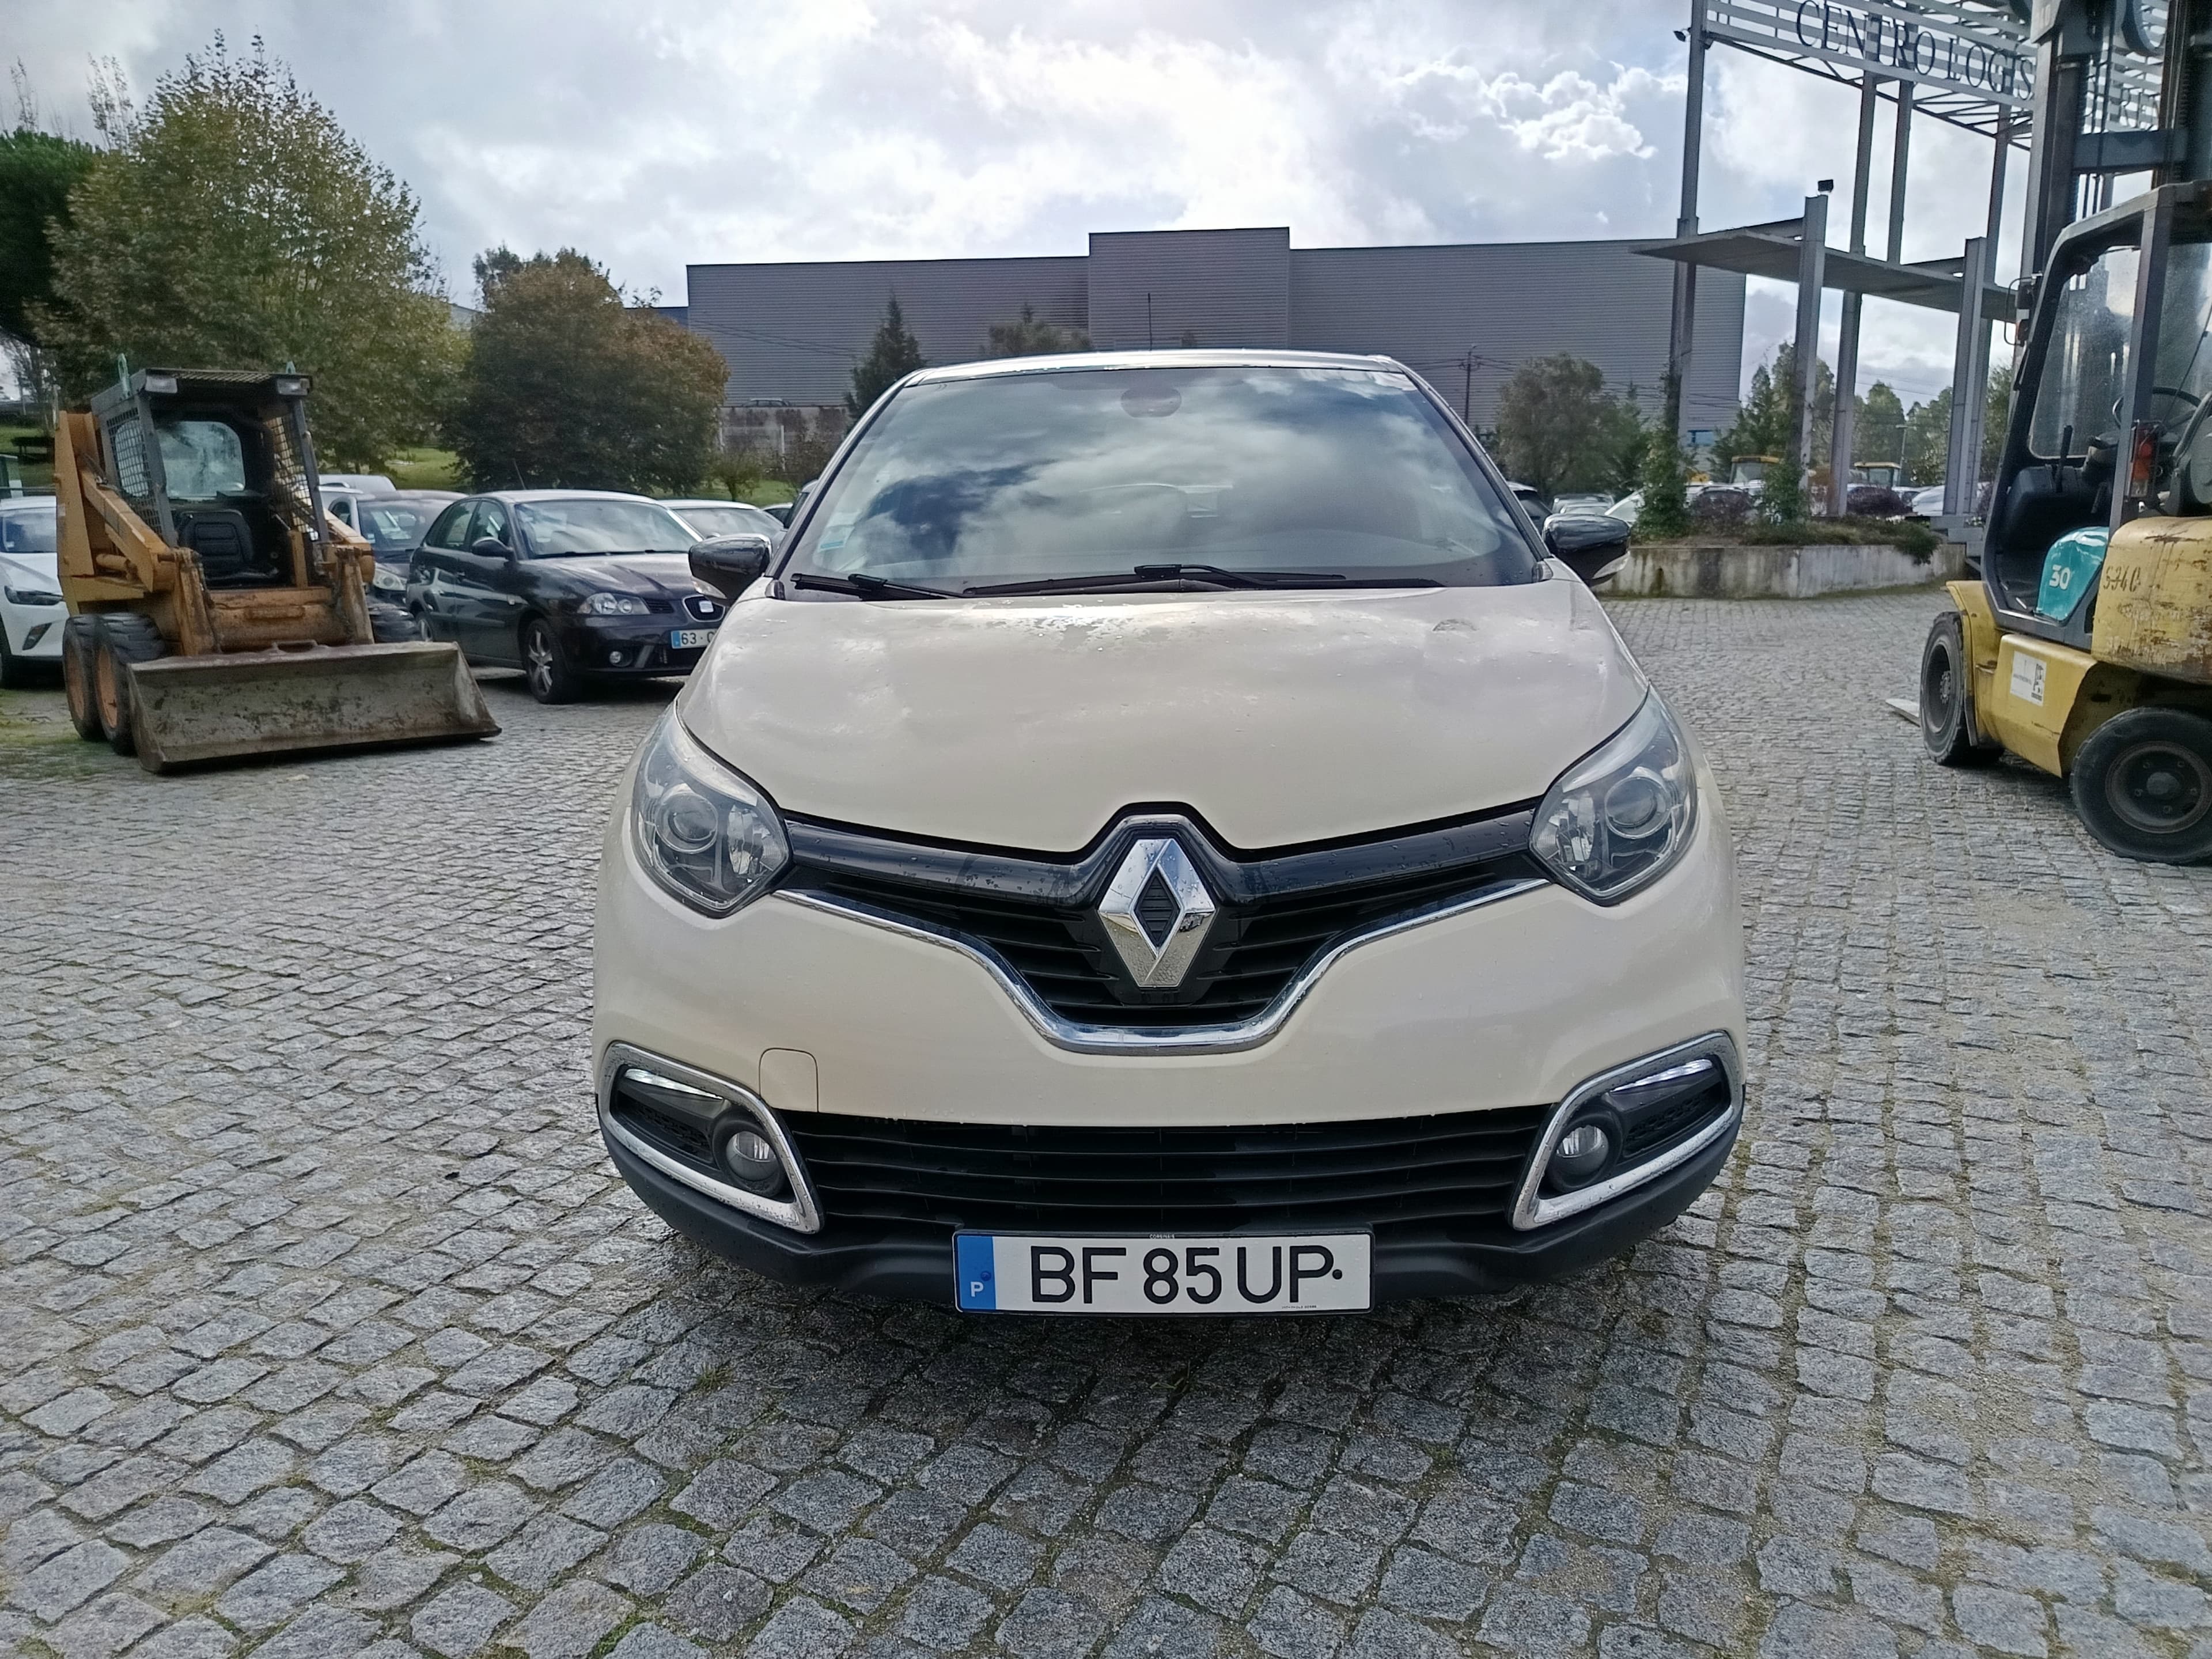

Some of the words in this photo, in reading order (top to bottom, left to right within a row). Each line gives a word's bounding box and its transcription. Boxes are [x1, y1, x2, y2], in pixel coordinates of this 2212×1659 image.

[1797, 0, 1936, 75] CENTRO
[2049, 564, 2071, 590] 30
[970, 1281, 984, 1297] P
[1031, 1245, 1127, 1304] BF
[1143, 1248, 1222, 1304] 85
[1237, 1245, 1334, 1304] UP
